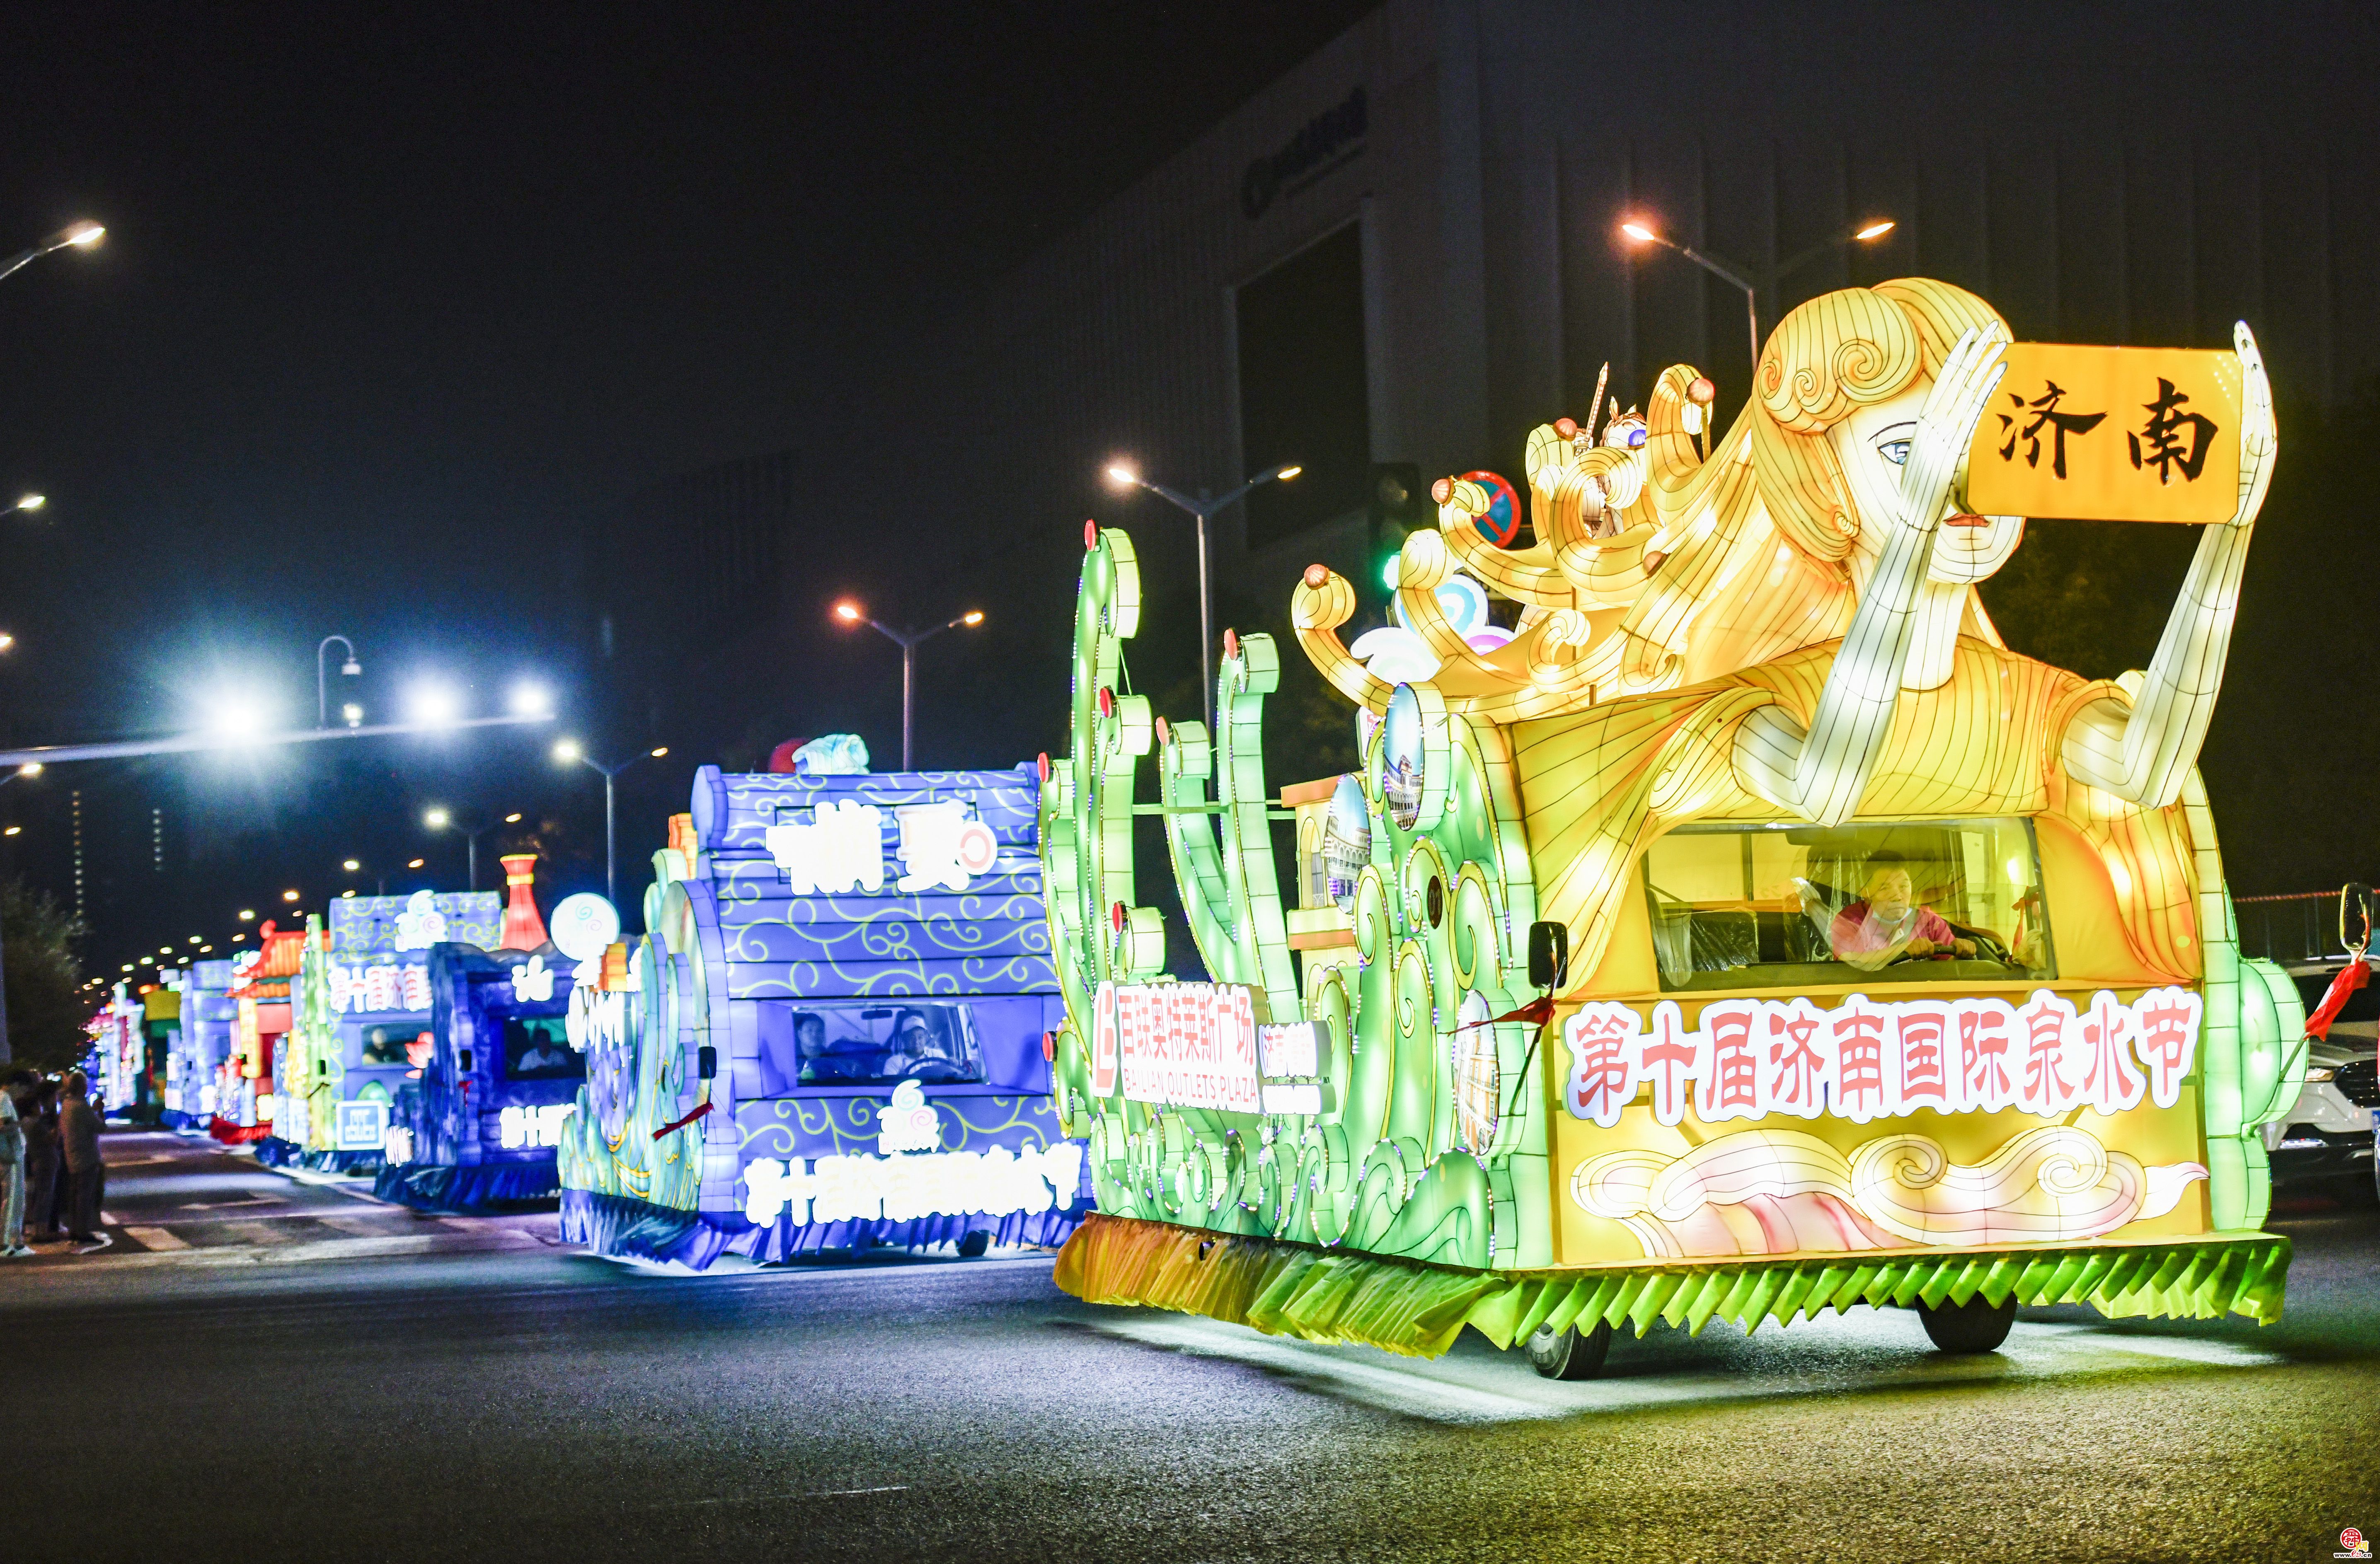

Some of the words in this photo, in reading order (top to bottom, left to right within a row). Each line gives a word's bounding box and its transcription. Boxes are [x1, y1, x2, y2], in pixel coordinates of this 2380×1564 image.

[1996, 377, 2218, 486] 济南
[1119, 993, 1254, 1066] 百联奥特莱斯广场
[1576, 998, 2191, 1116] 第十届济南国际泉水节
[1124, 1068, 1164, 1094] BAILIAN
[1168, 1071, 1215, 1100] OUTLETS
[1220, 1076, 1257, 1103] PLAZA
